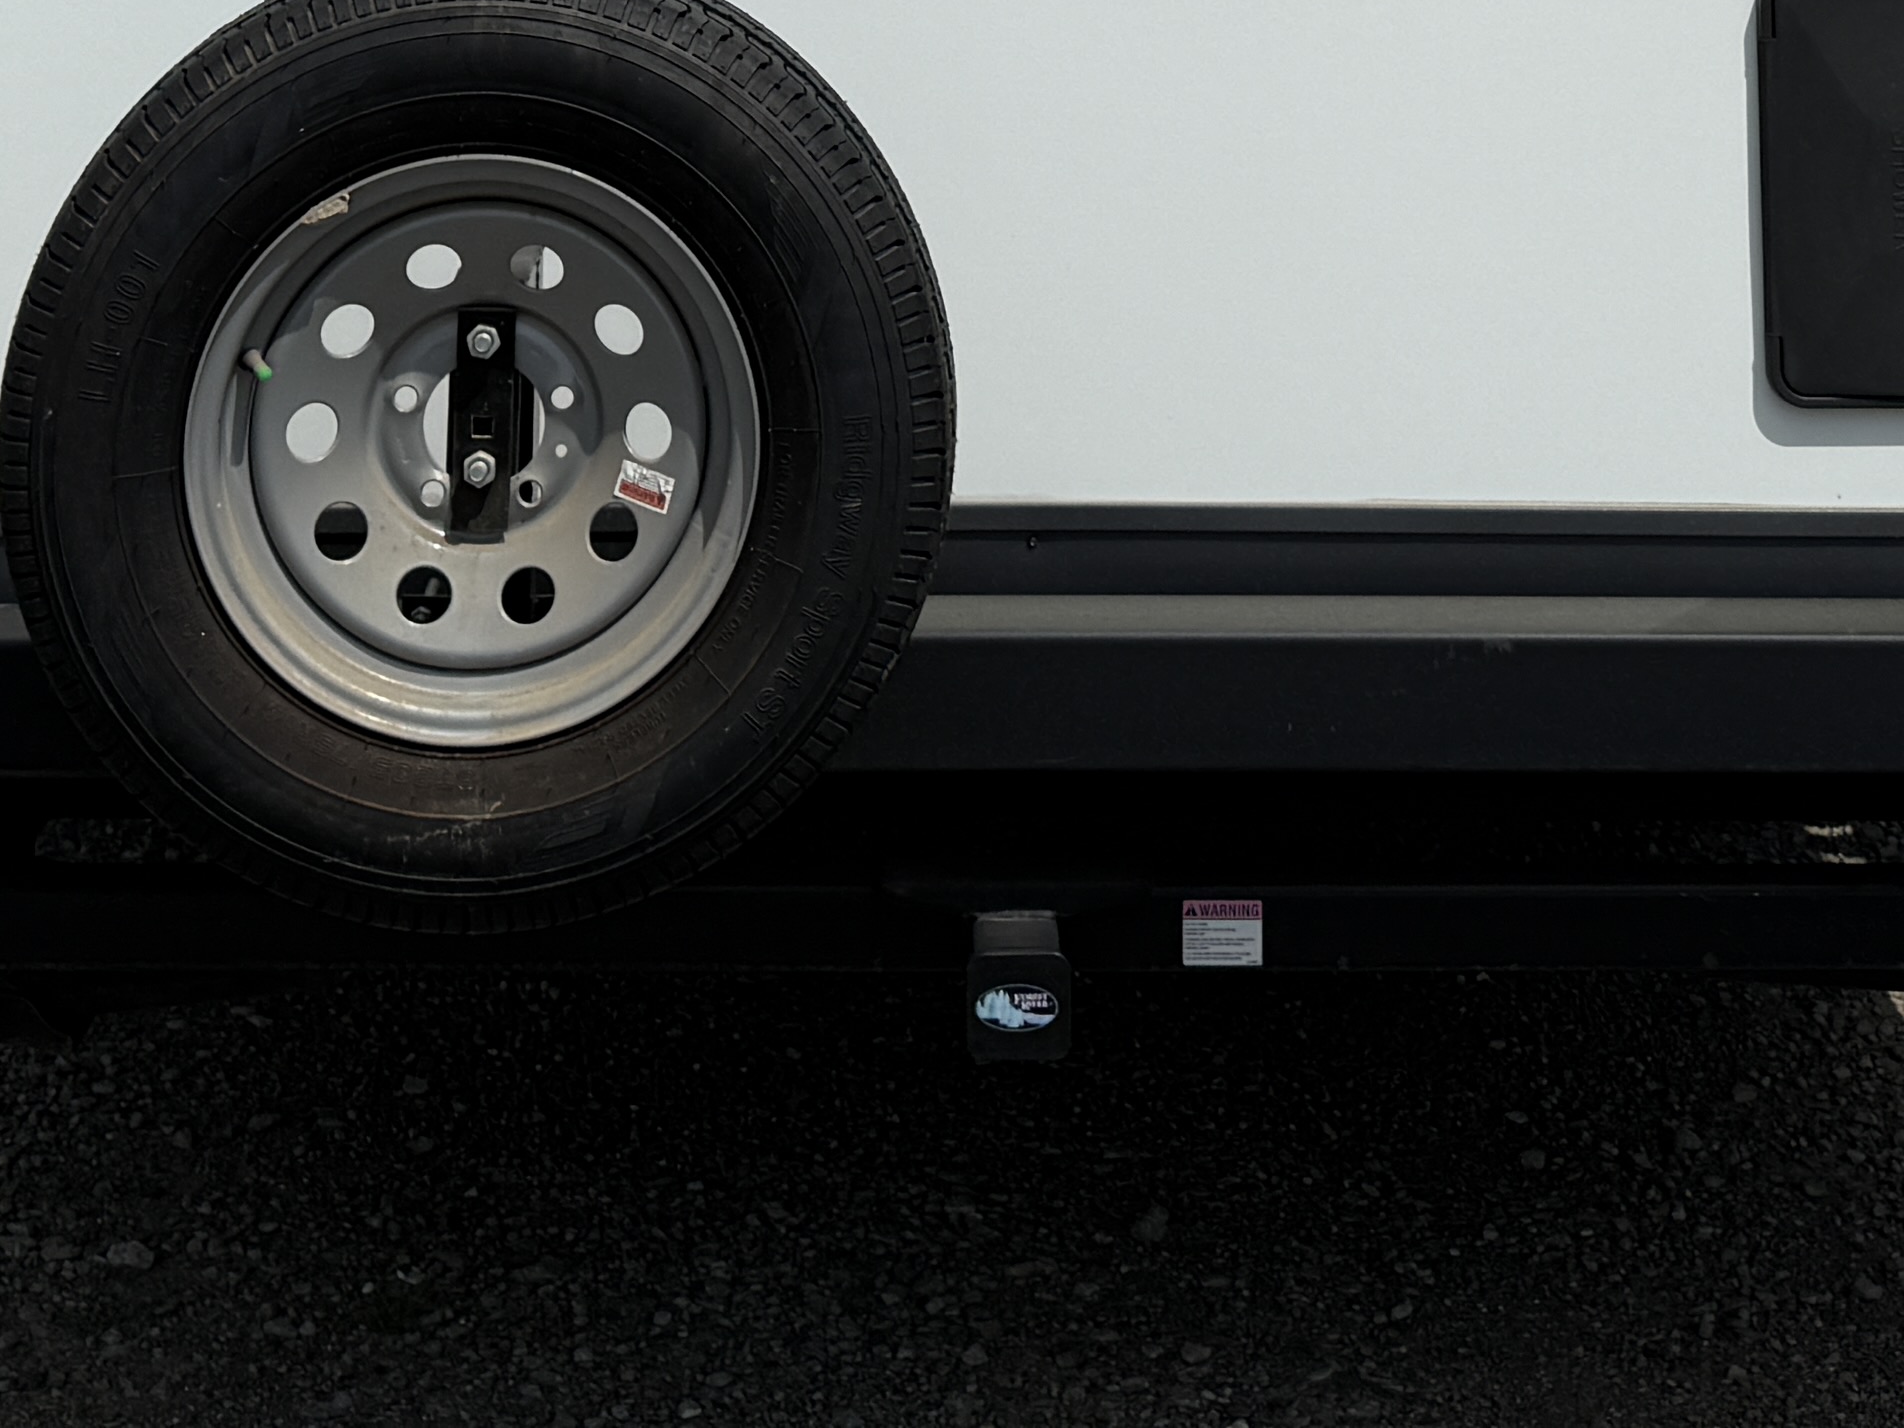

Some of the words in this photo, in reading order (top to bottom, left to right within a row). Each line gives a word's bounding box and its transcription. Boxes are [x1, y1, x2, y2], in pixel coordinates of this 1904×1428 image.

[821, 414, 873, 579] Ridgway
[775, 586, 844, 690] Sport
[1199, 903, 1260, 917] WARNING
